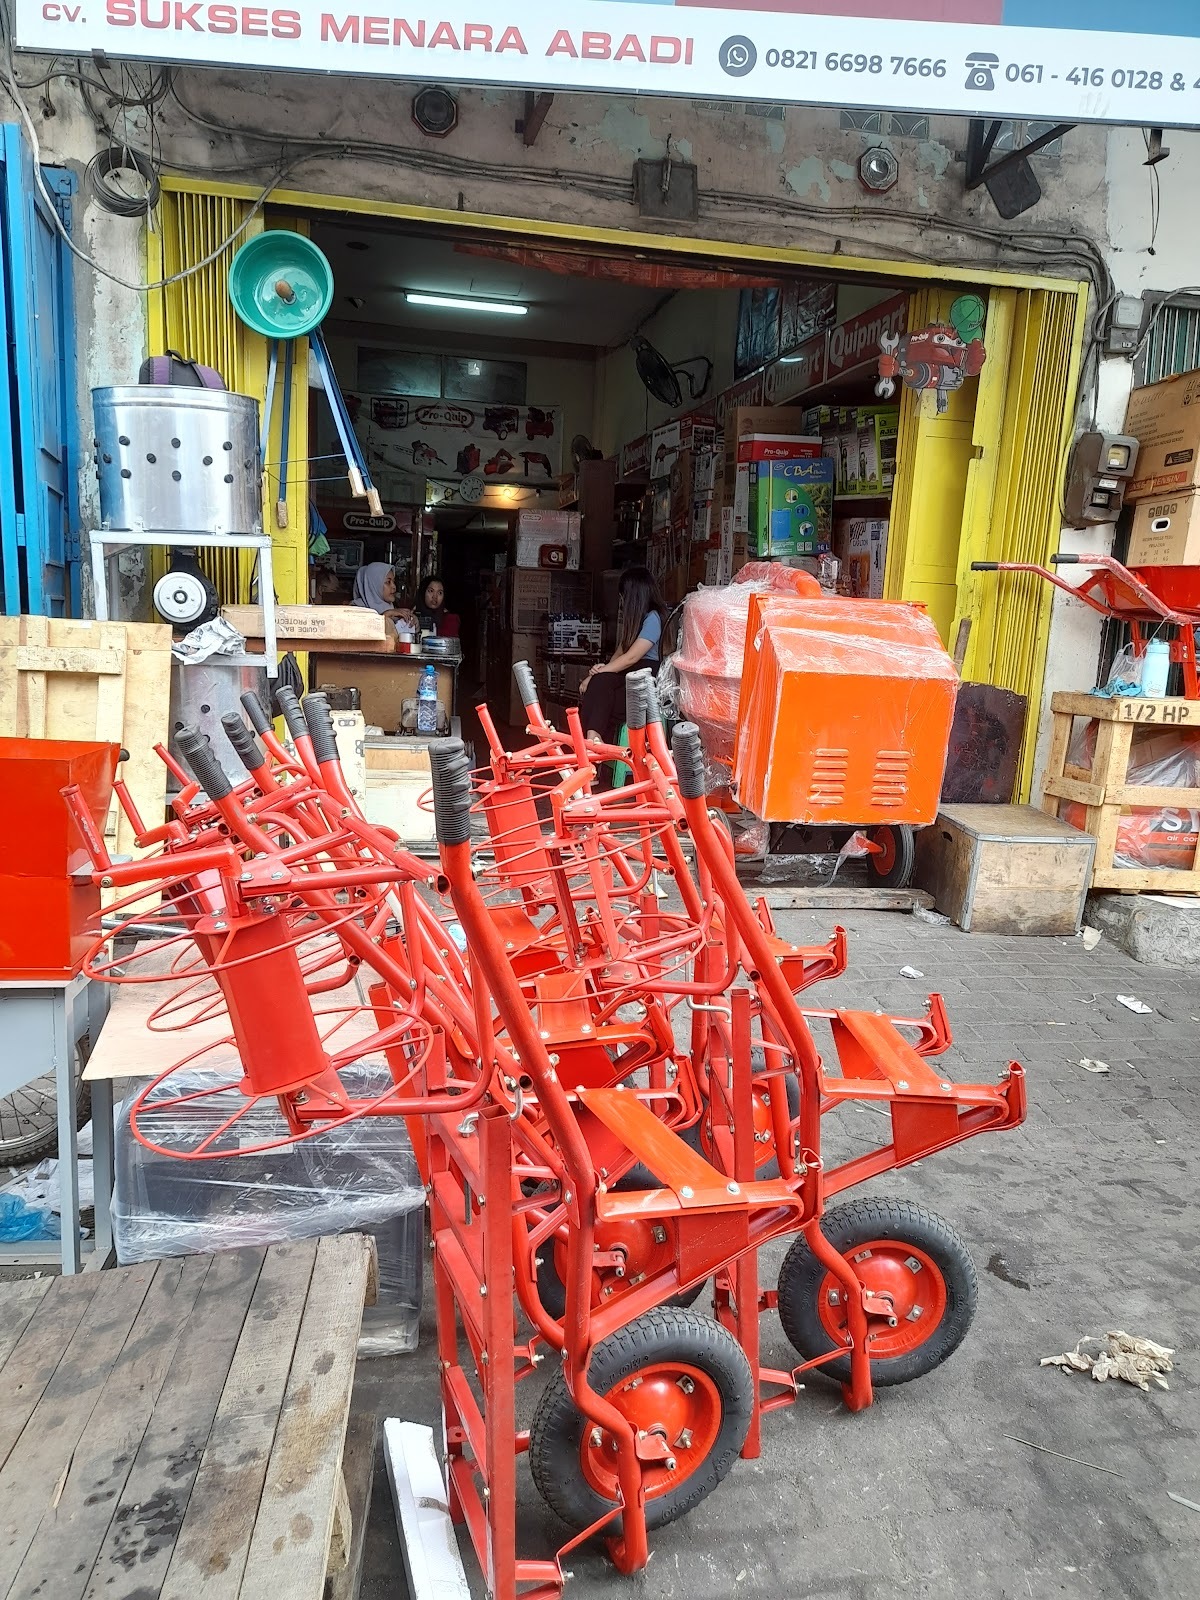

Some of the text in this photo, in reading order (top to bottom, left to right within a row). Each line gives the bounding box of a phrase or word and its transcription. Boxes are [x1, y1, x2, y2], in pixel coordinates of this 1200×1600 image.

[42, 0, 693, 64] CV. SUKSES MENARA ABADI
[765, 48, 947, 78] 0821 6698 7666
[1005, 63, 1044, 84] 061
[1065, 66, 1105, 87] 416
[1111, 69, 1163, 90] 0128
[1169, 72, 1186, 92] &
[830, 302, 906, 368] Quipmart
[765, 346, 821, 402] Quipmart
[422, 410, 468, 424] Pro-Quip
[763, 447, 789, 456] Pro-Quip
[349, 515, 390, 528] Pro-Quip
[1124, 703, 1190, 724] 1/2 HP
